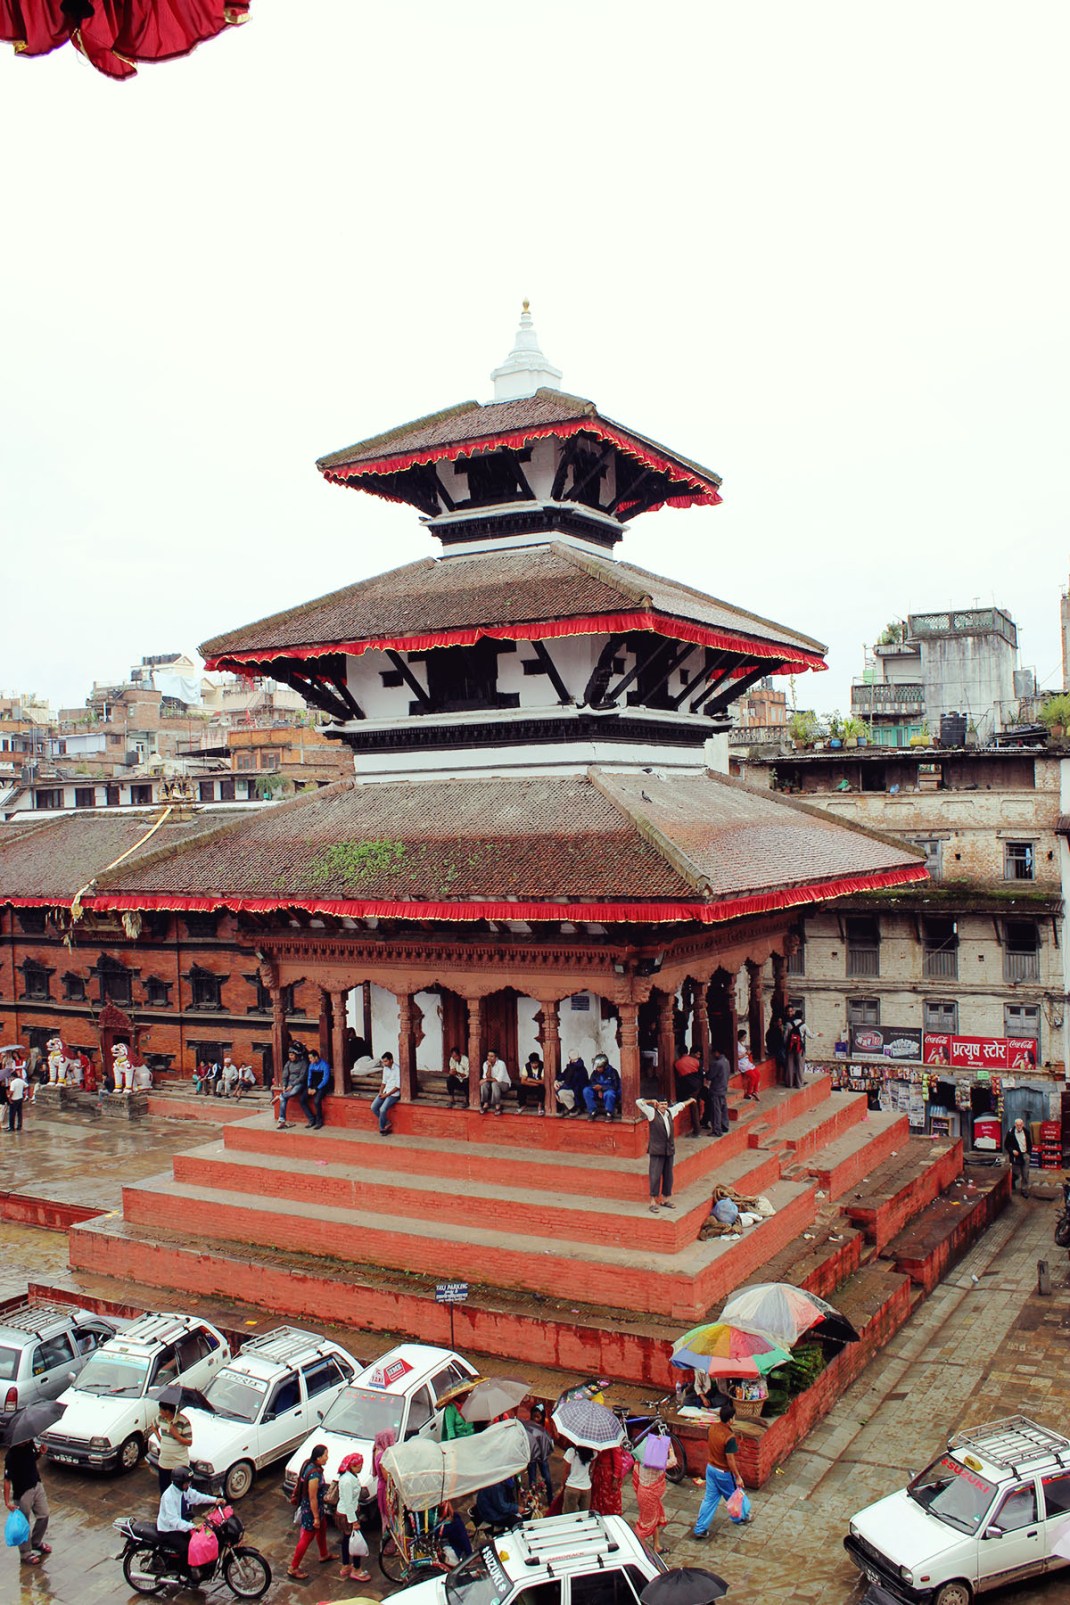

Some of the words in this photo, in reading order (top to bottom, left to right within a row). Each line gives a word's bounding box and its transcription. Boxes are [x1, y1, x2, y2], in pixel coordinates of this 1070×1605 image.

[983, 1040, 1006, 1059] स्टोर
[447, 1283, 469, 1291] PARKING
[946, 1461, 991, 1494] SUZUKI
[483, 1549, 505, 1587] SUZUKI
